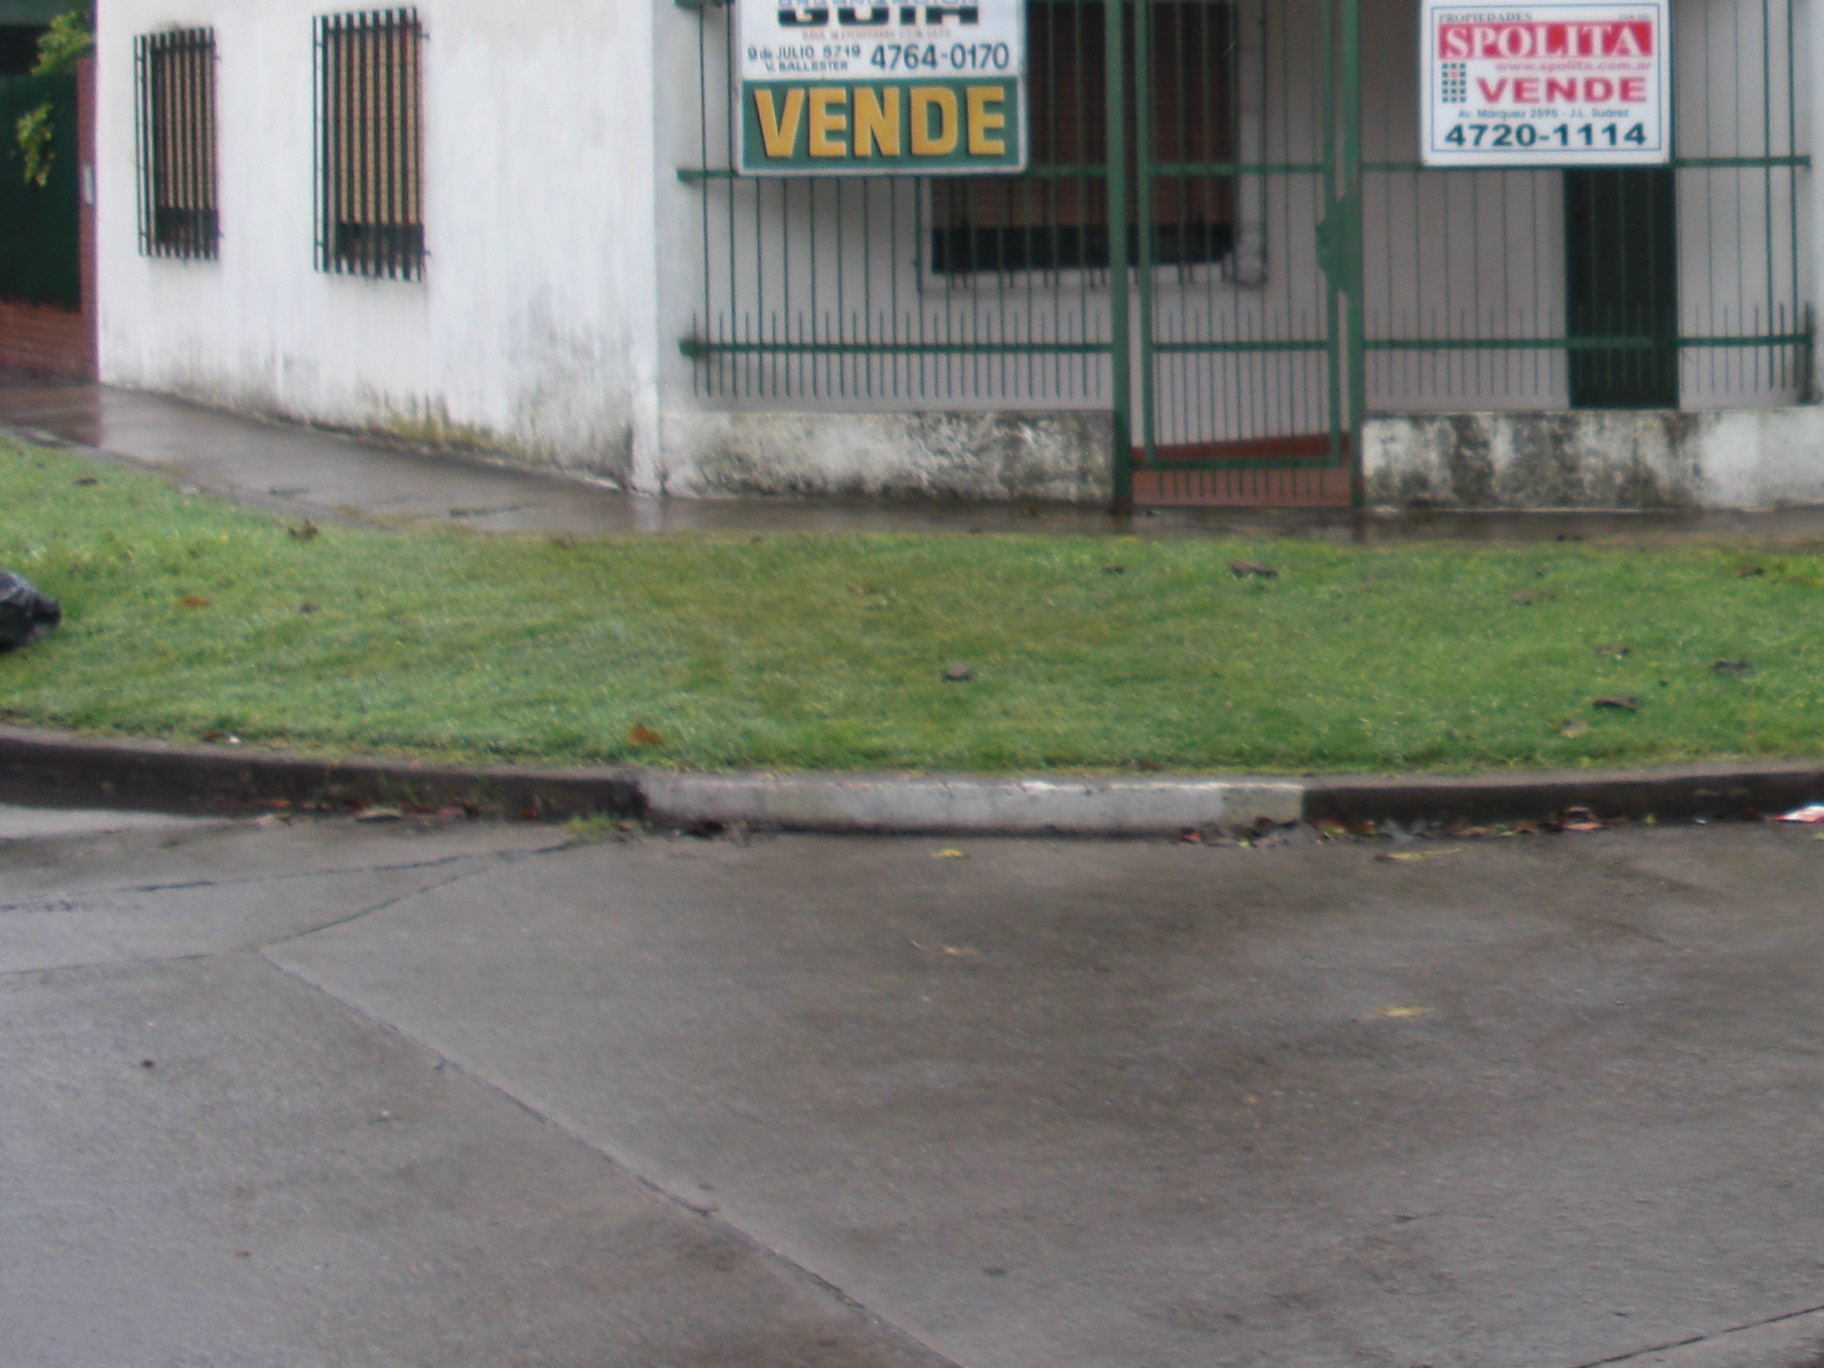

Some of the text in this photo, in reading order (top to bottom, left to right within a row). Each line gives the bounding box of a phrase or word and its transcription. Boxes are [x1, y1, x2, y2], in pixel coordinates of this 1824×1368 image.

[1439, 11, 1532, 22] PROPIEDADES
[747, 44, 861, 61] 9 de JULIO 5719
[1444, 24, 1646, 59] SPOLITA
[778, 60, 849, 72] BALLESTER
[870, 41, 1010, 70] 4764-0170
[1494, 60, 1652, 72] www.spolita.com.ar
[1476, 77, 1647, 104] VENDE
[753, 86, 1006, 157] VENDE
[1445, 122, 1647, 148] 4720-1114
